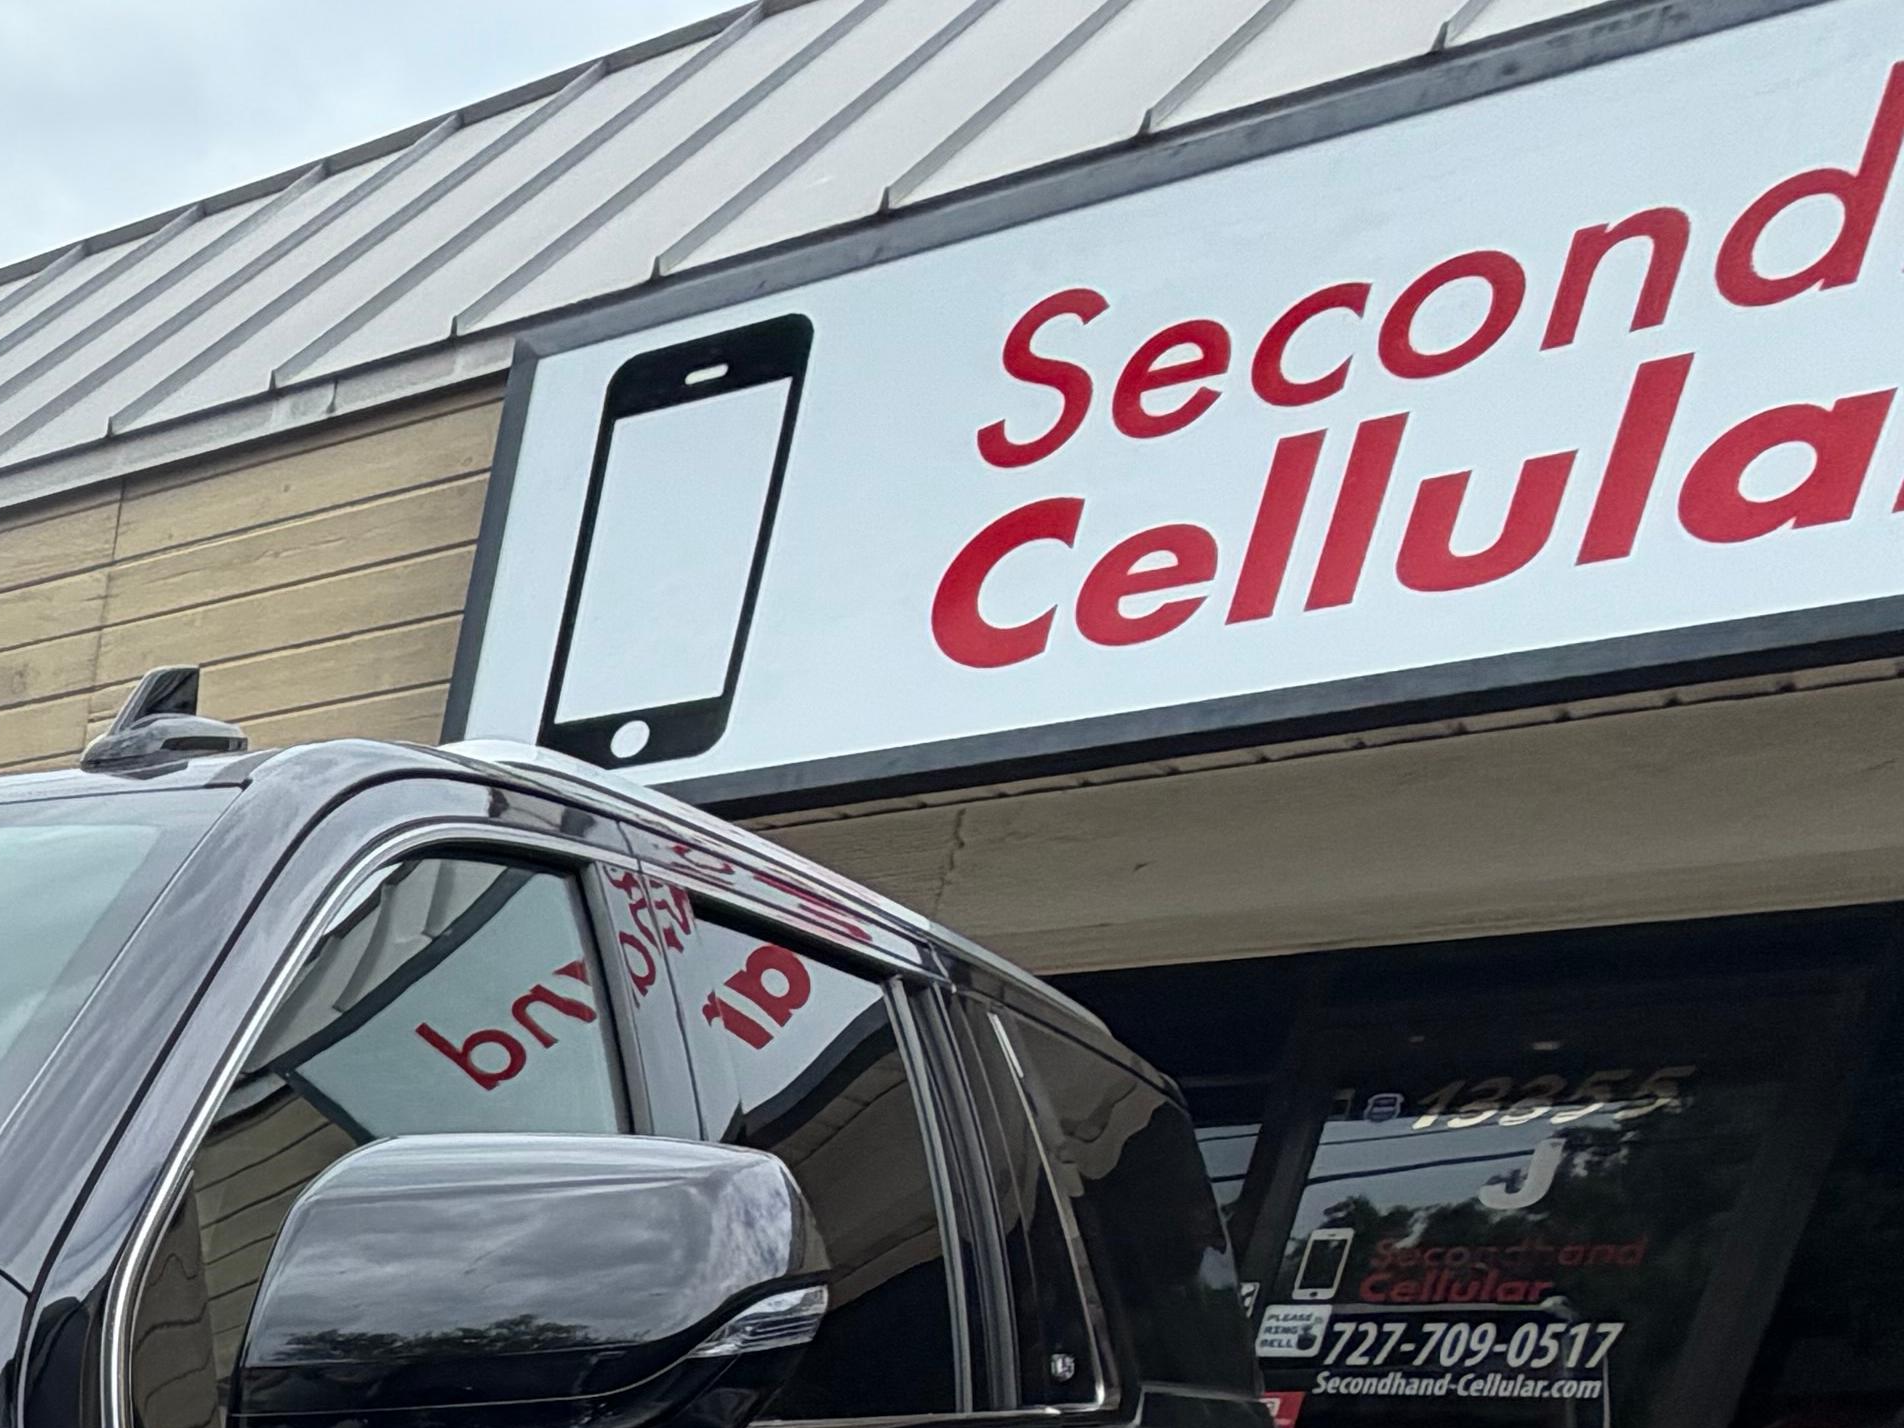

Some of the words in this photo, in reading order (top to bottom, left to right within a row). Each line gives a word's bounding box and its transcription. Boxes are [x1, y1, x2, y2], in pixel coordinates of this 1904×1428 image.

[976, 58, 1904, 470] Second
[930, 350, 1904, 670] Cellula
[1479, 1137, 1568, 1209] J
[1359, 1267, 1555, 1303] Cellular
[1263, 1325, 1298, 1335] RING
[1266, 1313, 1313, 1322] PLEASE
[1259, 1339, 1292, 1348] BELL
[1322, 1322, 1624, 1368] 727-709-0517
[1311, 1371, 1602, 1399] Secondhand-Cellular.com
